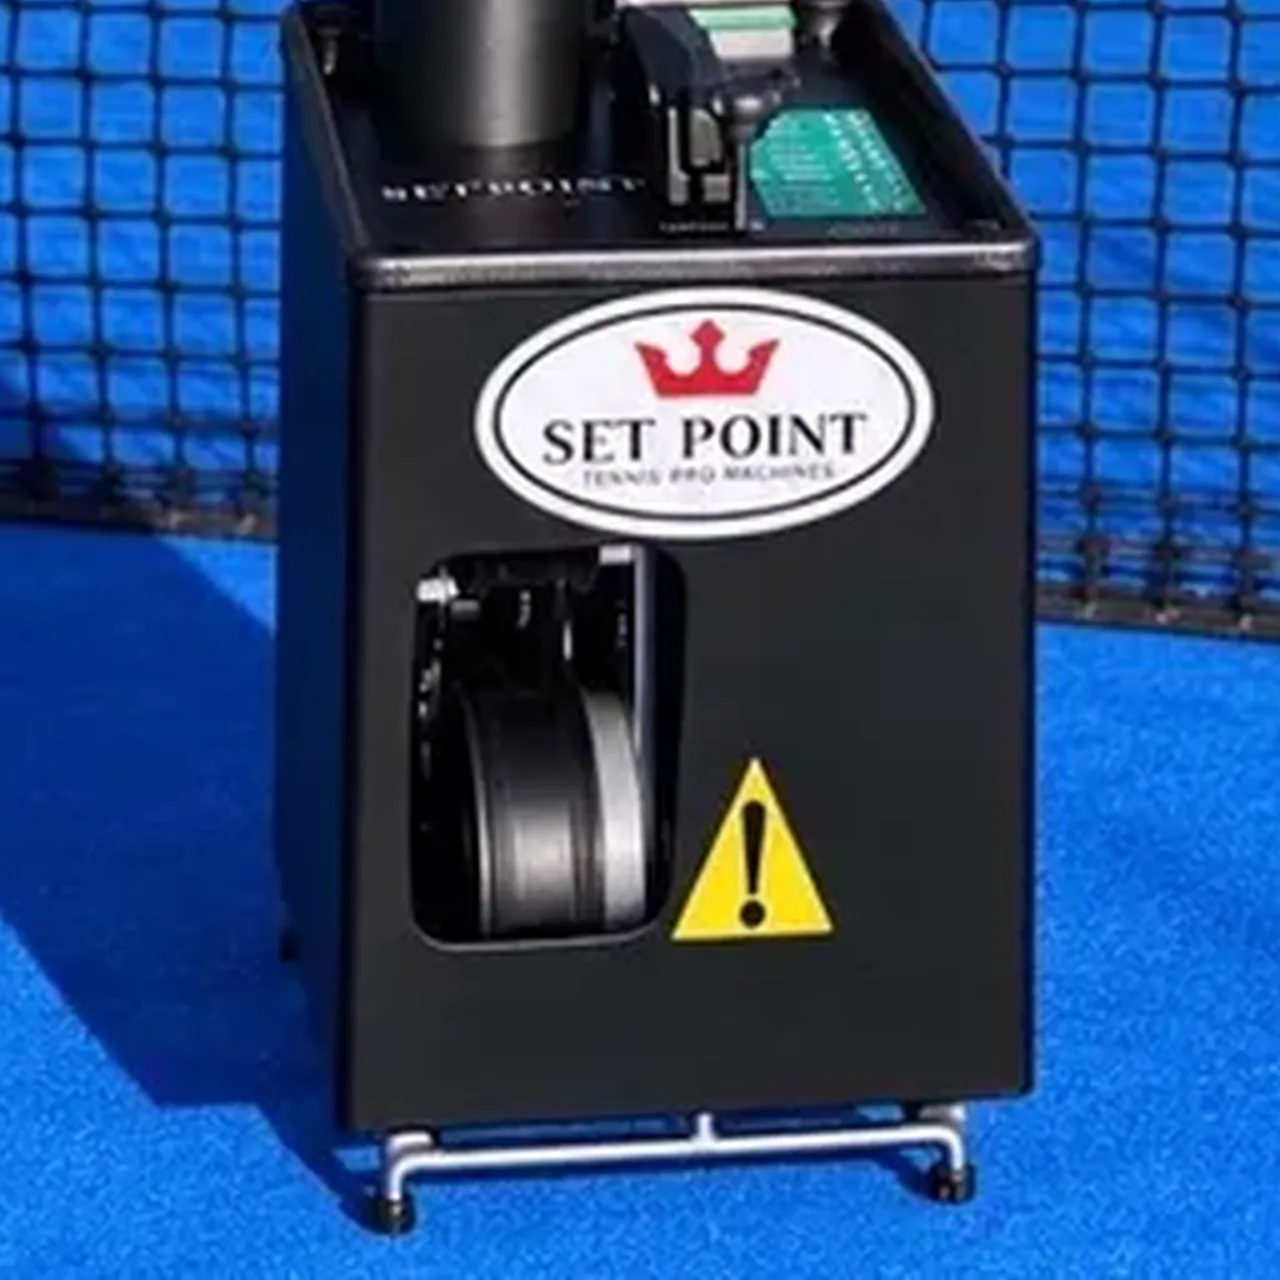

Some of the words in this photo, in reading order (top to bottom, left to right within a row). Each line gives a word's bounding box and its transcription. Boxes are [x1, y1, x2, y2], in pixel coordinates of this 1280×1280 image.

[542, 417, 656, 466] SET
[681, 412, 869, 460] POINT
[583, 467, 661, 488] TENNIS
[670, 467, 716, 486] PRO
[723, 462, 835, 484] MACHINES
